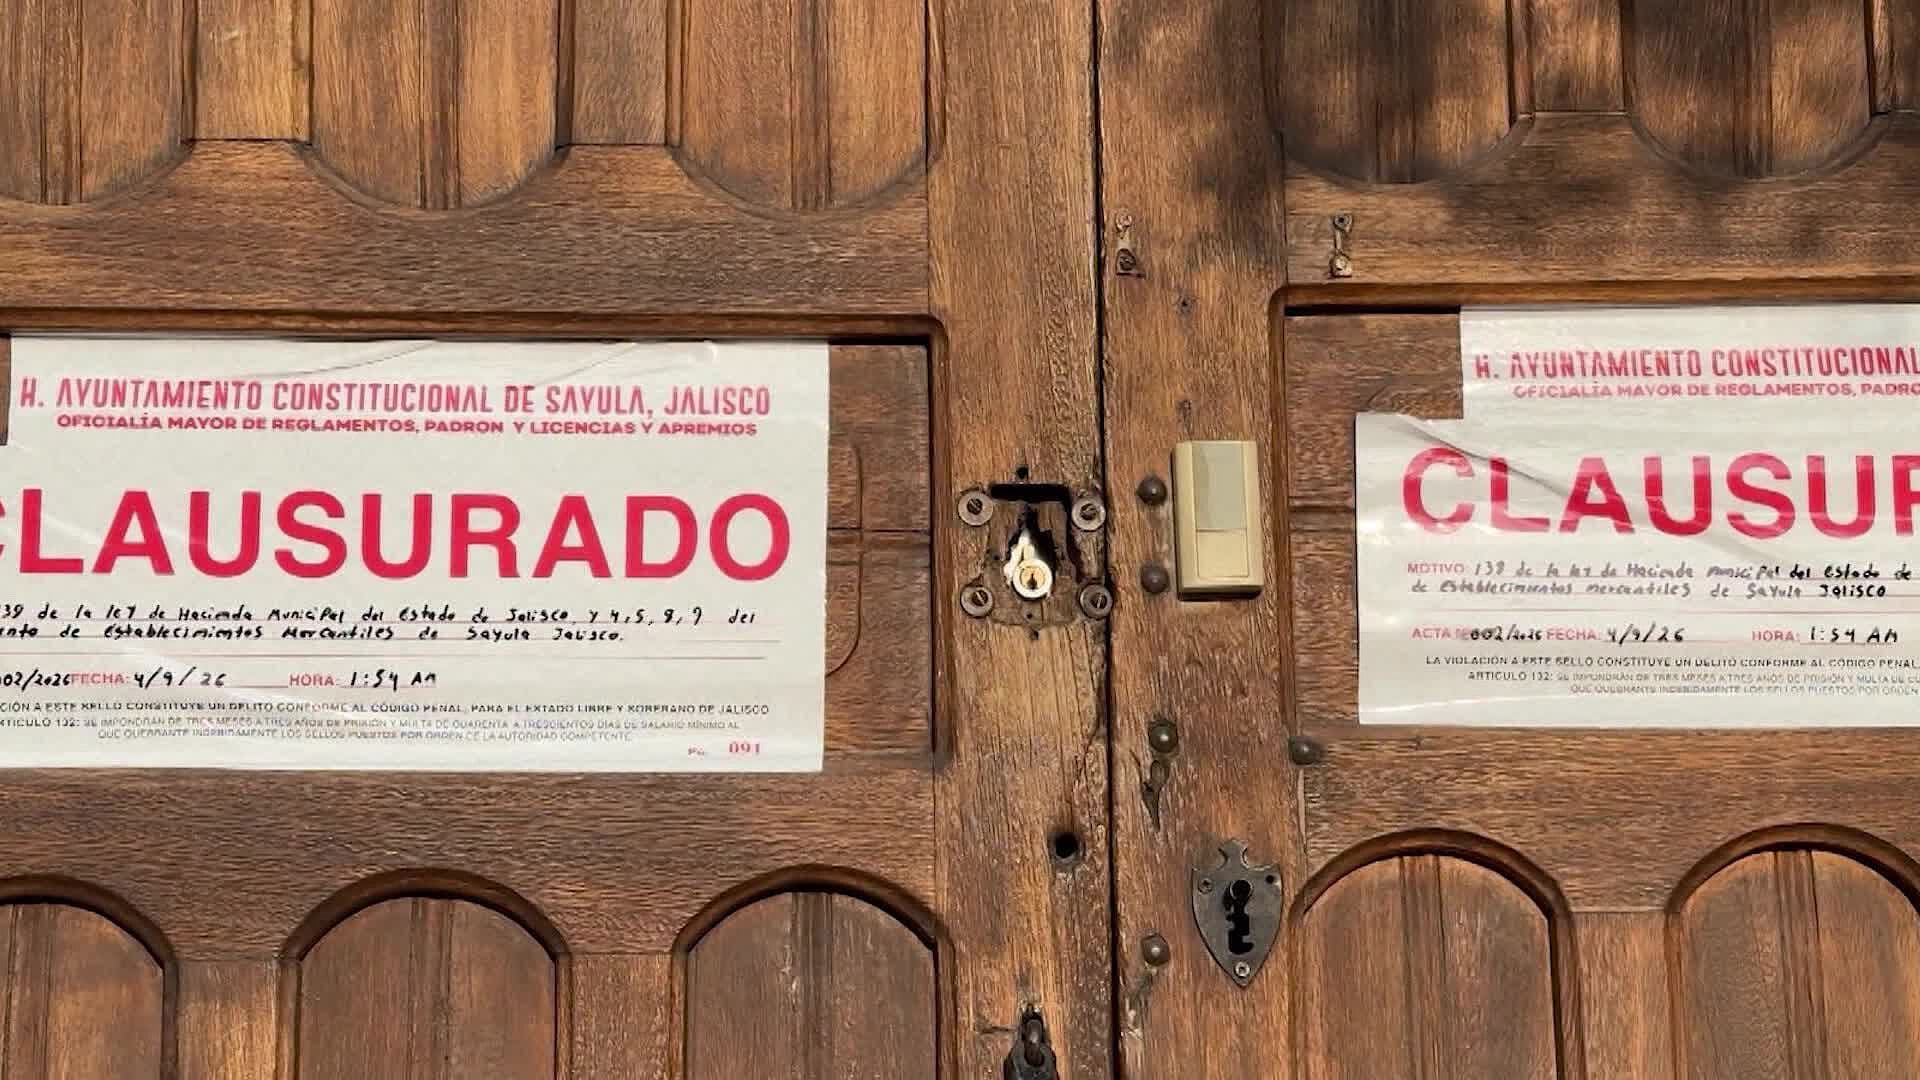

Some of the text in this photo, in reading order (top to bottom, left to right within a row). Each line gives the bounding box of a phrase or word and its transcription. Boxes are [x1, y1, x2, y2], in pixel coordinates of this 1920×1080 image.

[1475, 347, 1920, 378] H. AYUNTAMIENTO CONSTITUCIONAL
[19, 377, 771, 417] H. AYUNTAMIENTO CONSTITUCIONAL DE SAYULA, JALISCO
[1617, 384, 1682, 396] MAYOR
[1687, 383, 1710, 396] DE
[1715, 383, 1857, 397] REGLAMENTOS,
[56, 412, 758, 436] OFICIALÍA MAYOR DE REGLAMENTOS, PADRON Y LICENCIAS Y APREMIOS
[0, 488, 791, 582] LAUSURADO
[1789, 562, 1811, 579] del
[1894, 564, 1913, 580] de
[0, 603, 24, 619] 39
[38, 602, 59, 619] de
[75, 604, 92, 619] la
[149, 604, 166, 620] de
[361, 605, 384, 622] del
[471, 607, 489, 624] de
[728, 608, 756, 624] del
[60, 625, 80, 638] de
[418, 626, 438, 640] de
[466, 627, 530, 643] Sayula
[1412, 627, 1451, 639] ACTA
[0, 668, 70, 693] 02/2026
[71, 674, 129, 686] FECHA:
[33, 702, 42, 712] A
[351, 703, 367, 713] AL
[718, 704, 769, 715] JALISCO
